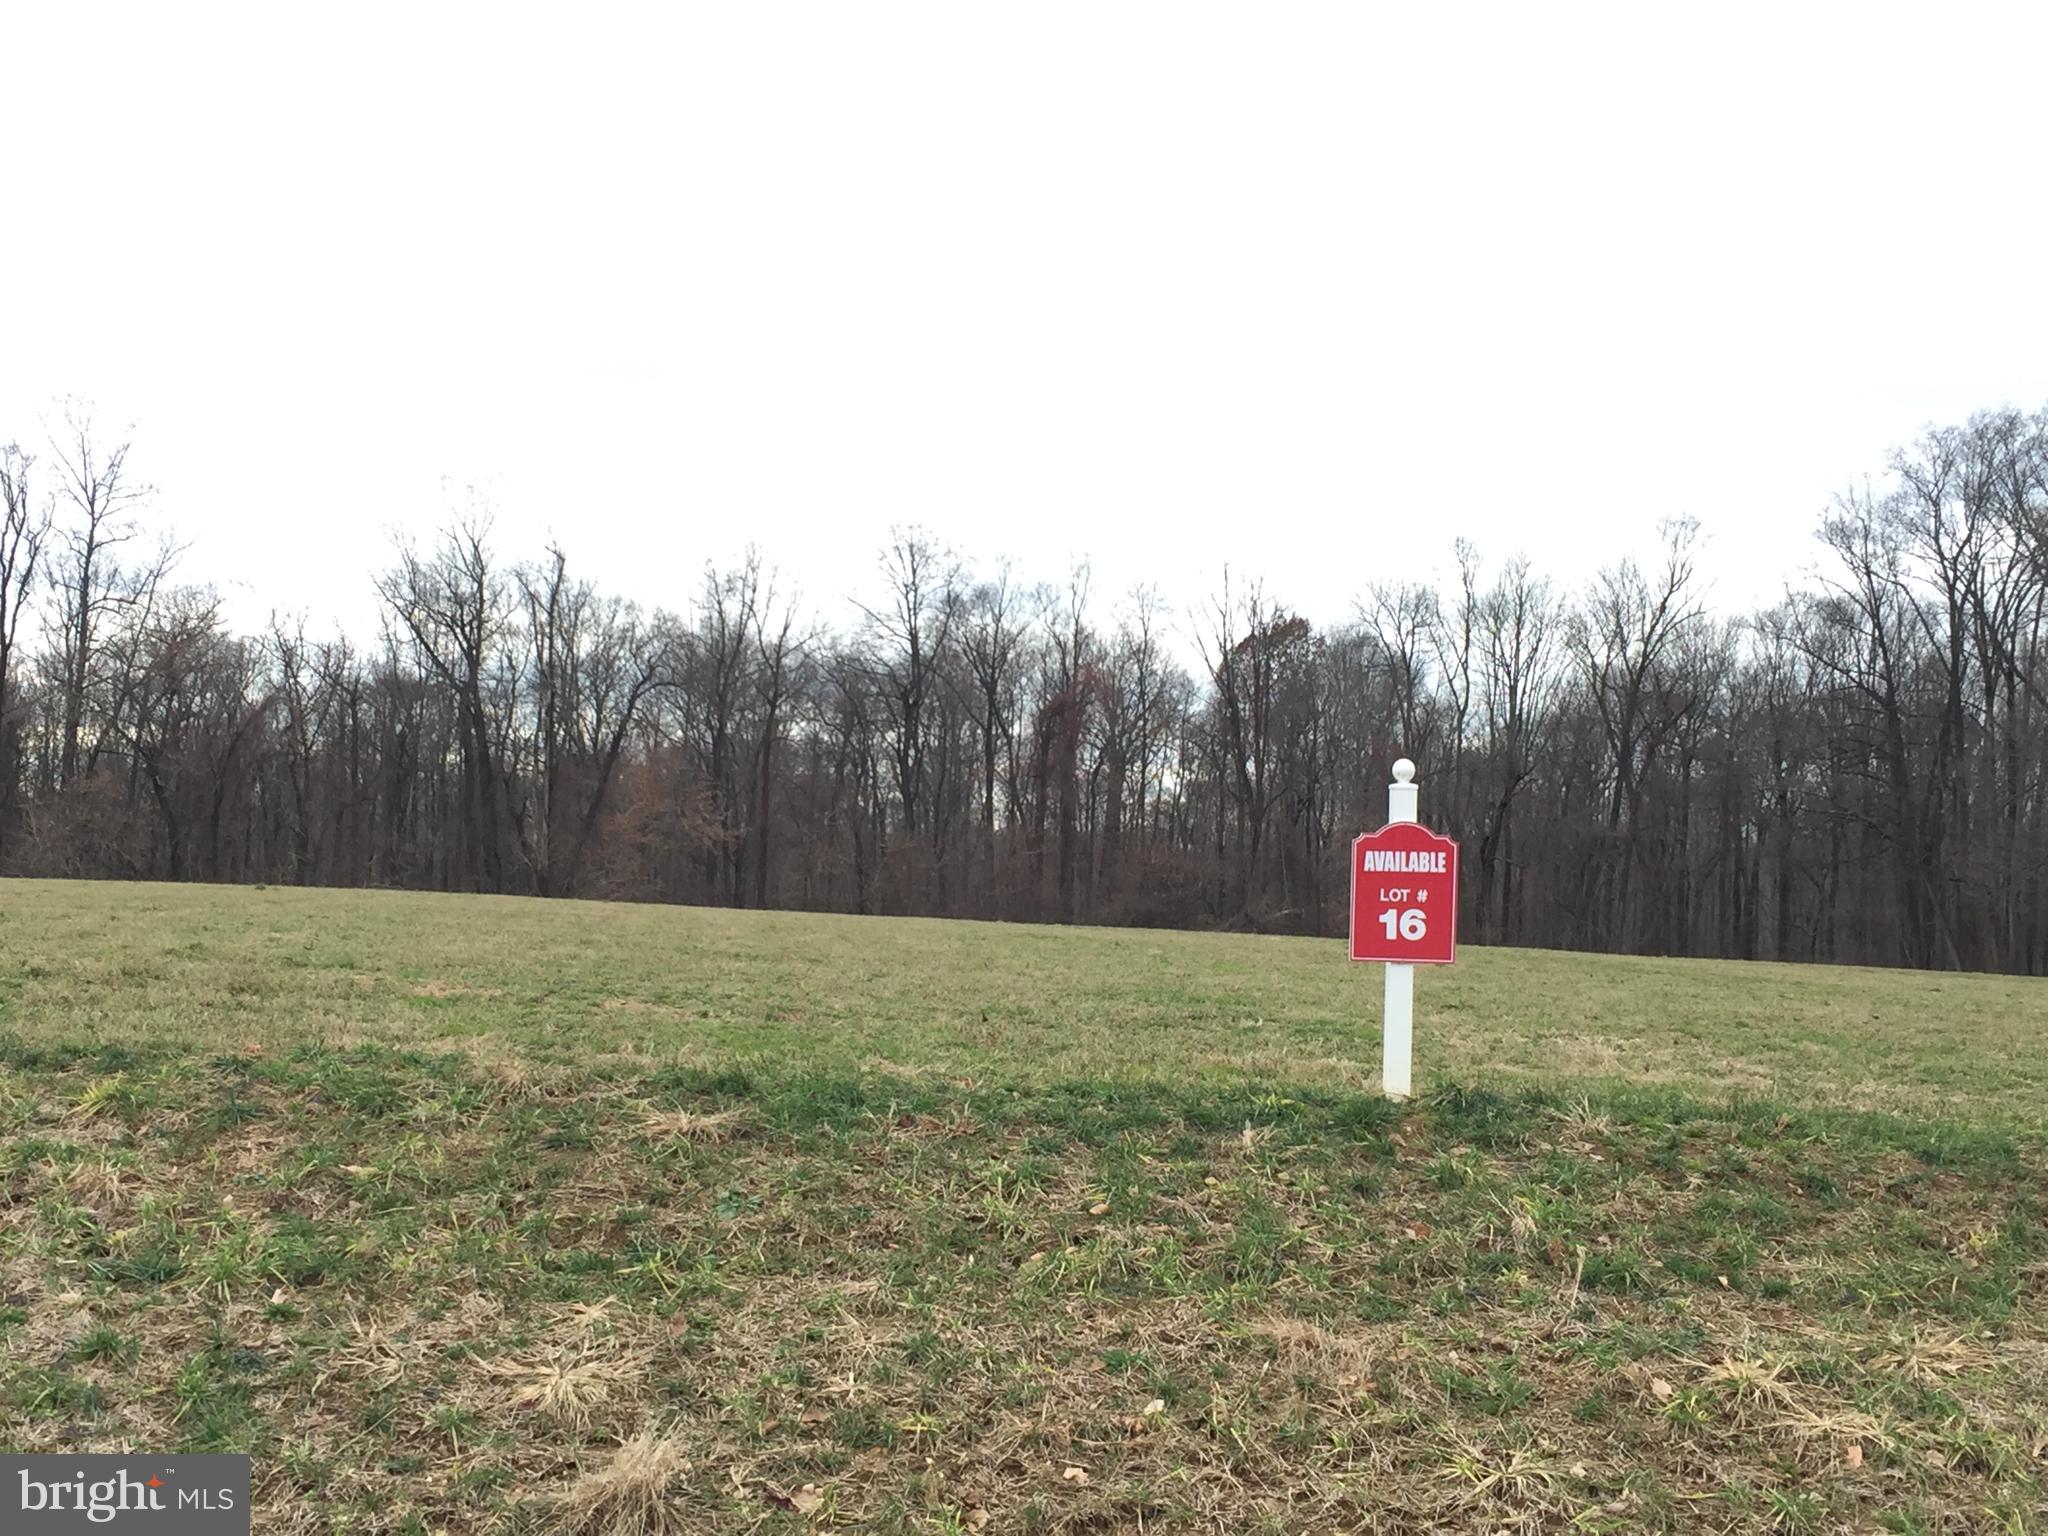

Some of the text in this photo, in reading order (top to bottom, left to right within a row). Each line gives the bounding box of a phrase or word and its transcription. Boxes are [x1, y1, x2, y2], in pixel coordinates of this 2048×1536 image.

[1363, 850, 1447, 873] AVAILABLE
[1379, 888, 1429, 903] LOT #
[1378, 908, 1427, 941] 16
